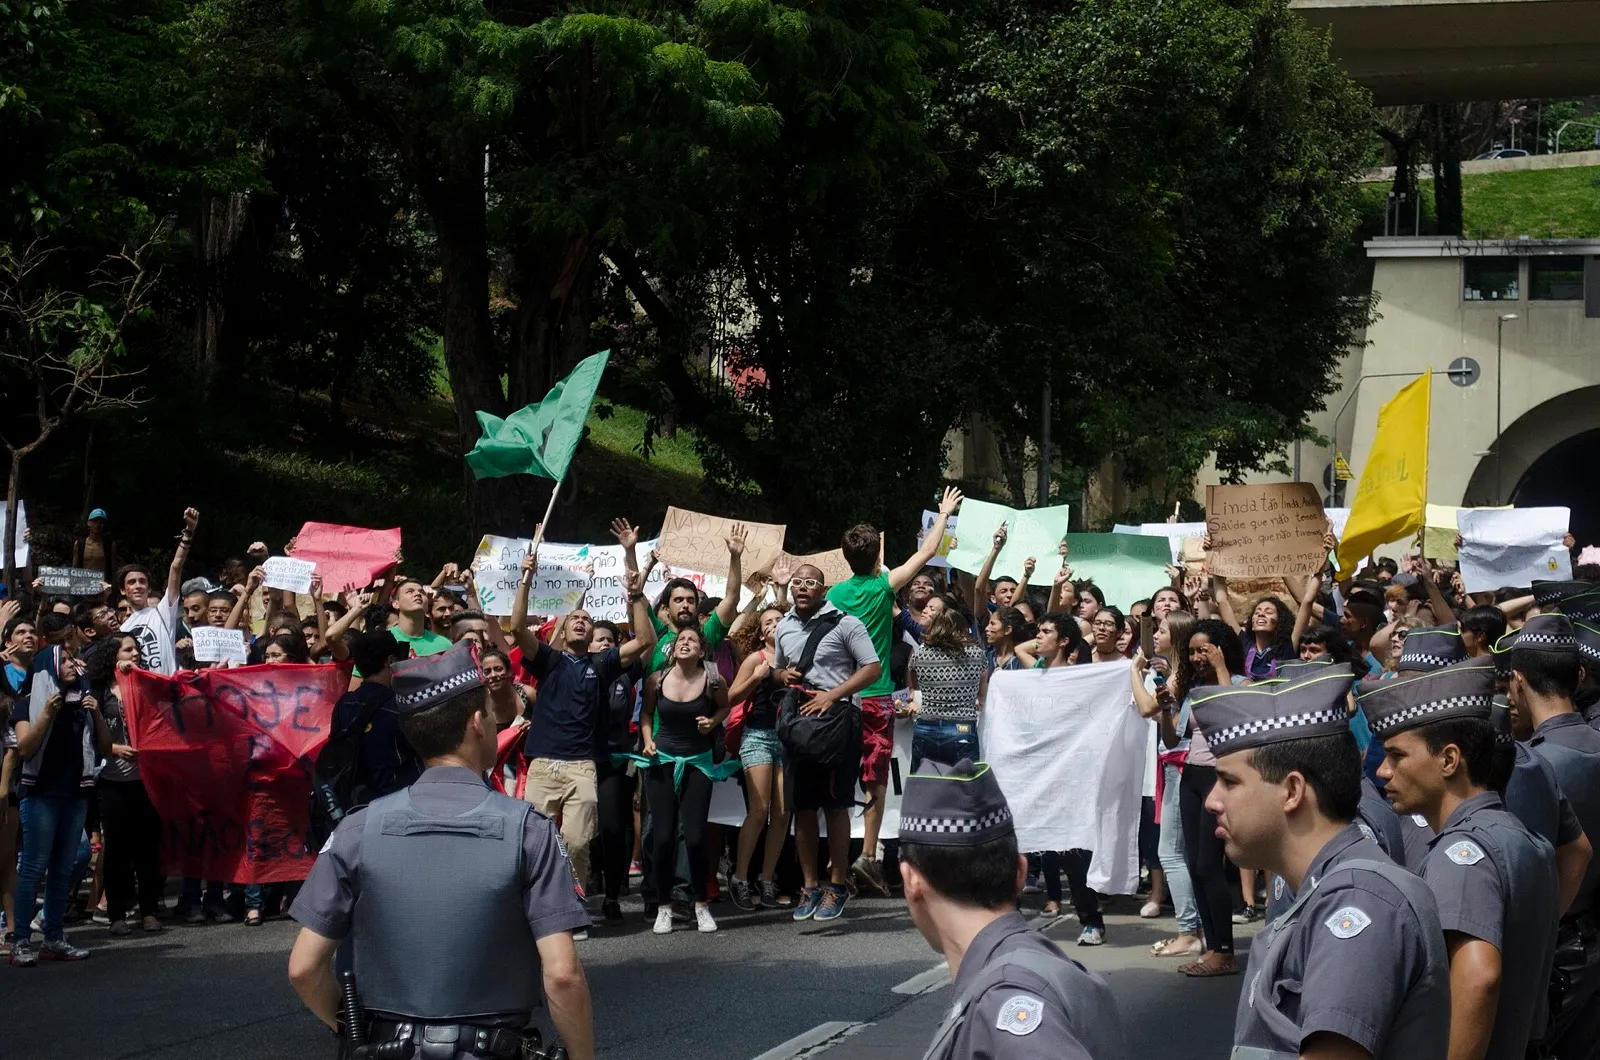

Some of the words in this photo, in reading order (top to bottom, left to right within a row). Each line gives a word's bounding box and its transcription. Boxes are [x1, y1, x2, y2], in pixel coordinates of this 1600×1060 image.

[1211, 487, 1258, 516] Linda
[1261, 492, 1277, 512] tão
[666, 508, 712, 535] NÃO
[714, 519, 782, 548] LTO
[1208, 517, 1246, 532] Saúde
[1250, 519, 1268, 531] que
[1270, 513, 1289, 526] não
[662, 531, 704, 551] POR
[702, 539, 762, 559] MM
[1258, 534, 1274, 546] que
[1276, 529, 1292, 539] não
[1210, 550, 1234, 565] Mas
[1237, 551, 1268, 564] atrás
[1274, 553, 1292, 562] dos
[1297, 551, 1326, 561] meus
[40, 567, 69, 576] DESDE
[499, 563, 517, 571] SUA
[1247, 564, 1260, 576] EU
[1262, 564, 1279, 574] VOU
[1283, 561, 1320, 573] LUTAR!
[44, 576, 71, 588] ECHAR
[194, 630, 205, 638] AS
[208, 630, 239, 641] ESCOLAS
